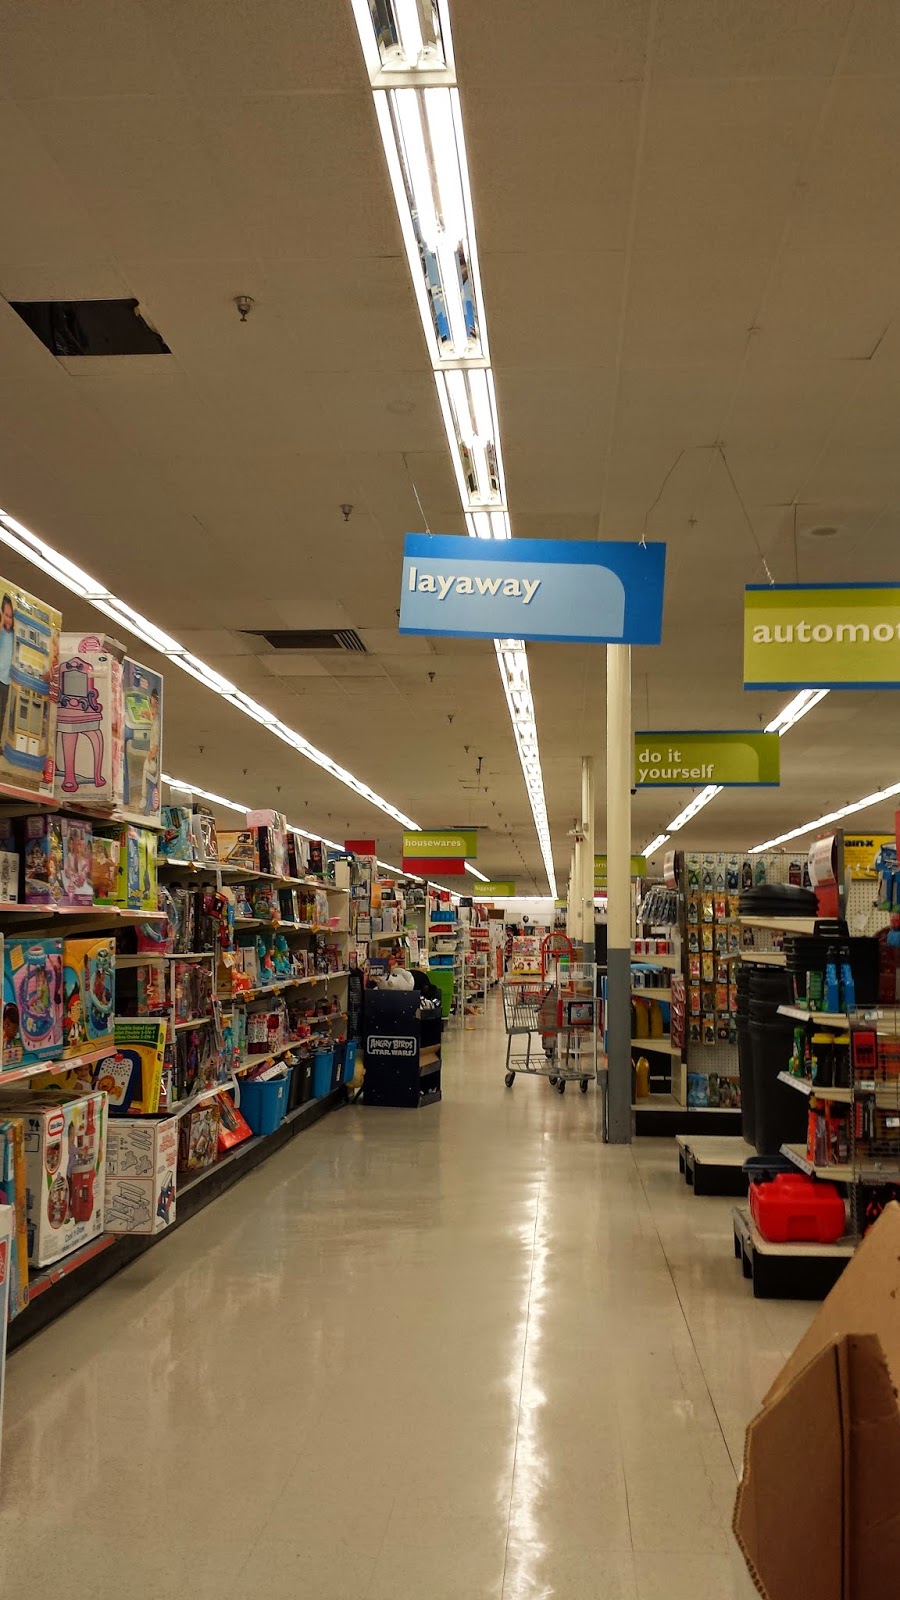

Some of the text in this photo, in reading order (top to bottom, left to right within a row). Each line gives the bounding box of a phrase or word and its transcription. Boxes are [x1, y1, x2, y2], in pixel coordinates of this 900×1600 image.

[408, 566, 541, 604] layaway
[638, 749, 681, 763] do it
[638, 764, 714, 782] yourself
[405, 839, 461, 847] housewares
[370, 1039, 413, 1049] ANGRY BIRDS
